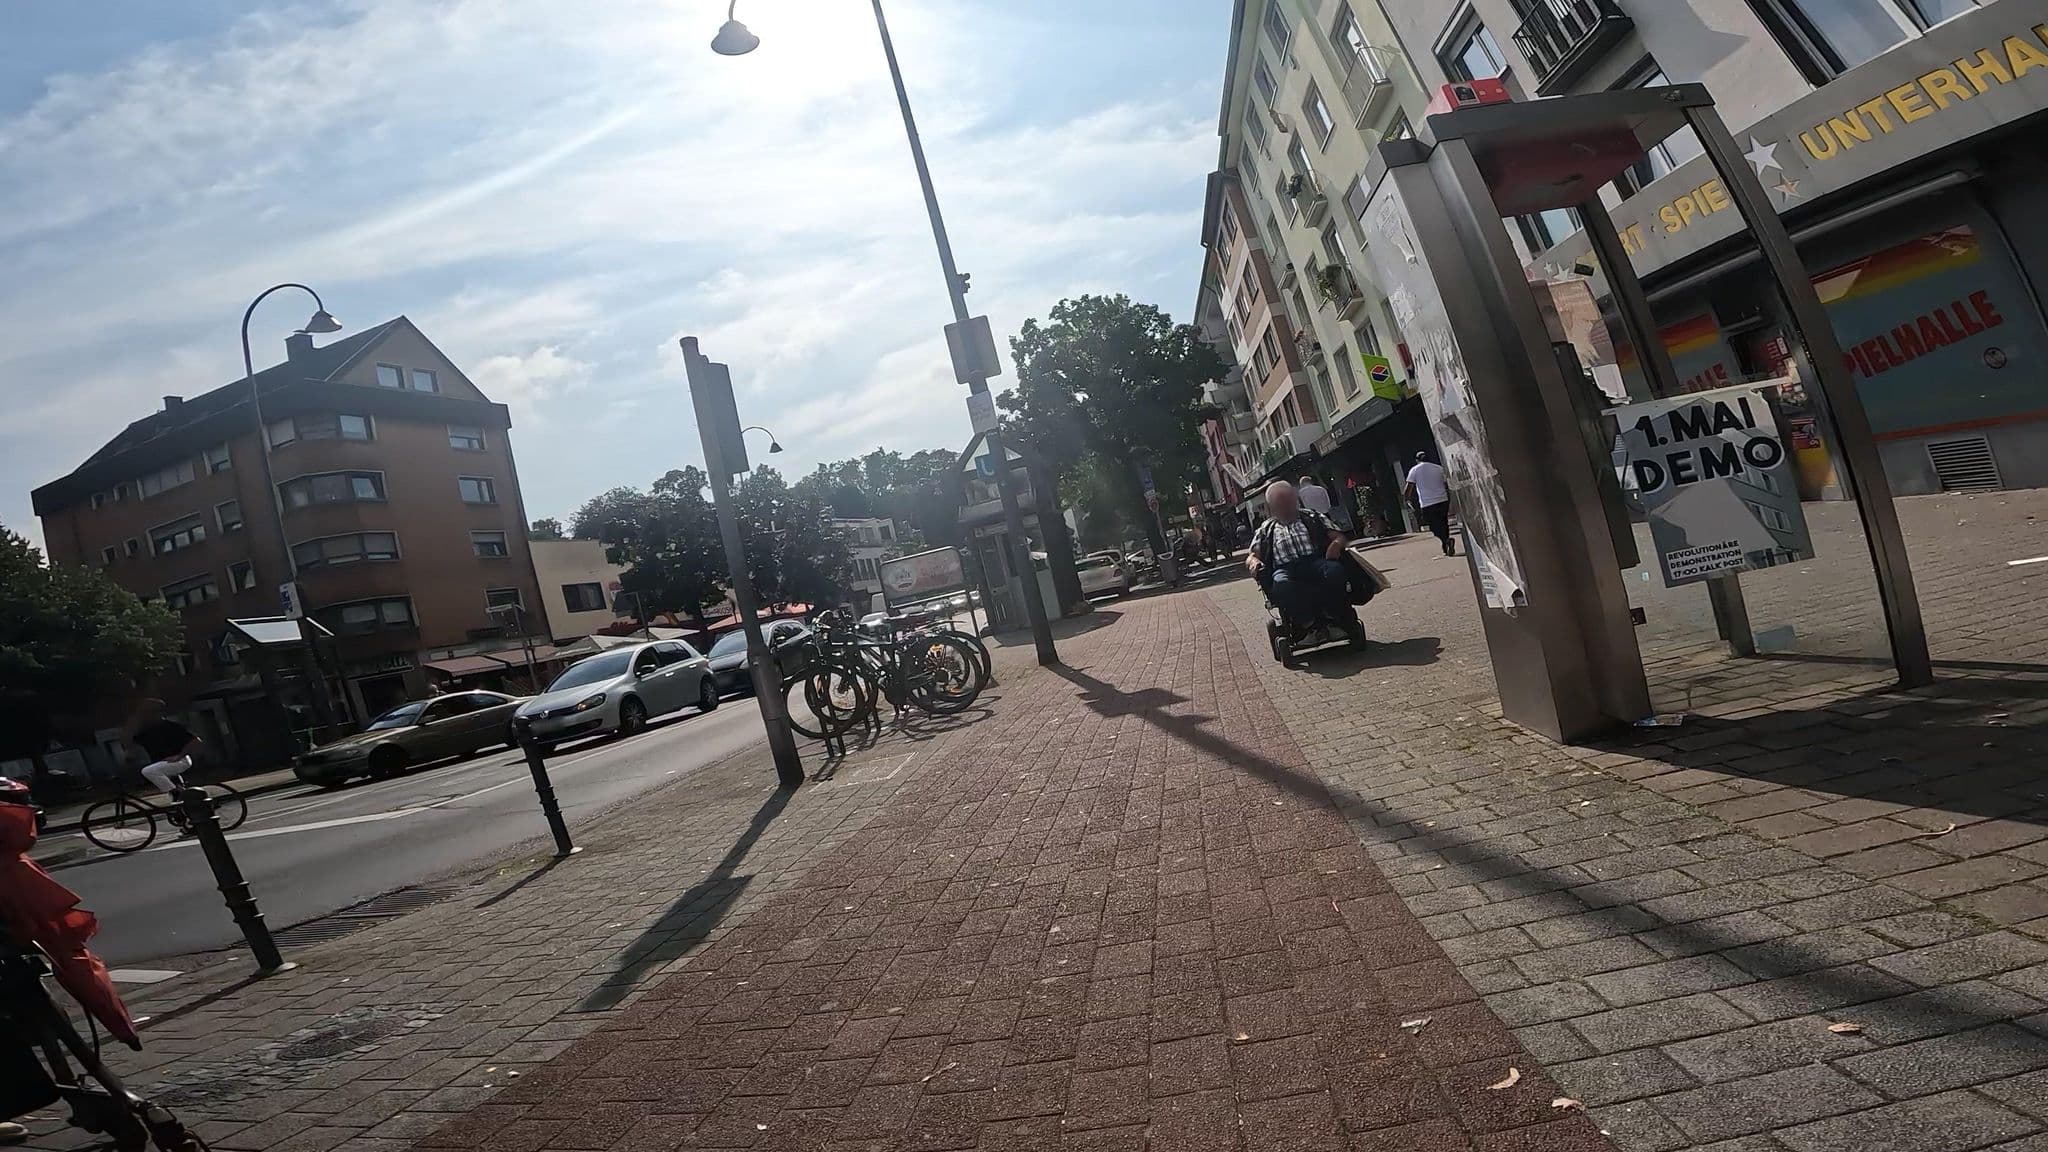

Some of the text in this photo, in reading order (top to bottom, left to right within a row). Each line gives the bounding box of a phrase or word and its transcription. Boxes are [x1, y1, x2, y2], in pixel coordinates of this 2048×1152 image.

[1658, 179, 1730, 234] SPIE
[1843, 290, 2004, 378] PIELHALLE
[1633, 436, 1783, 494] DEMO
[1670, 549, 1742, 569] DEMONSTRATION
[1699, 562, 1723, 573] KALK
[1723, 557, 1744, 568] POST
